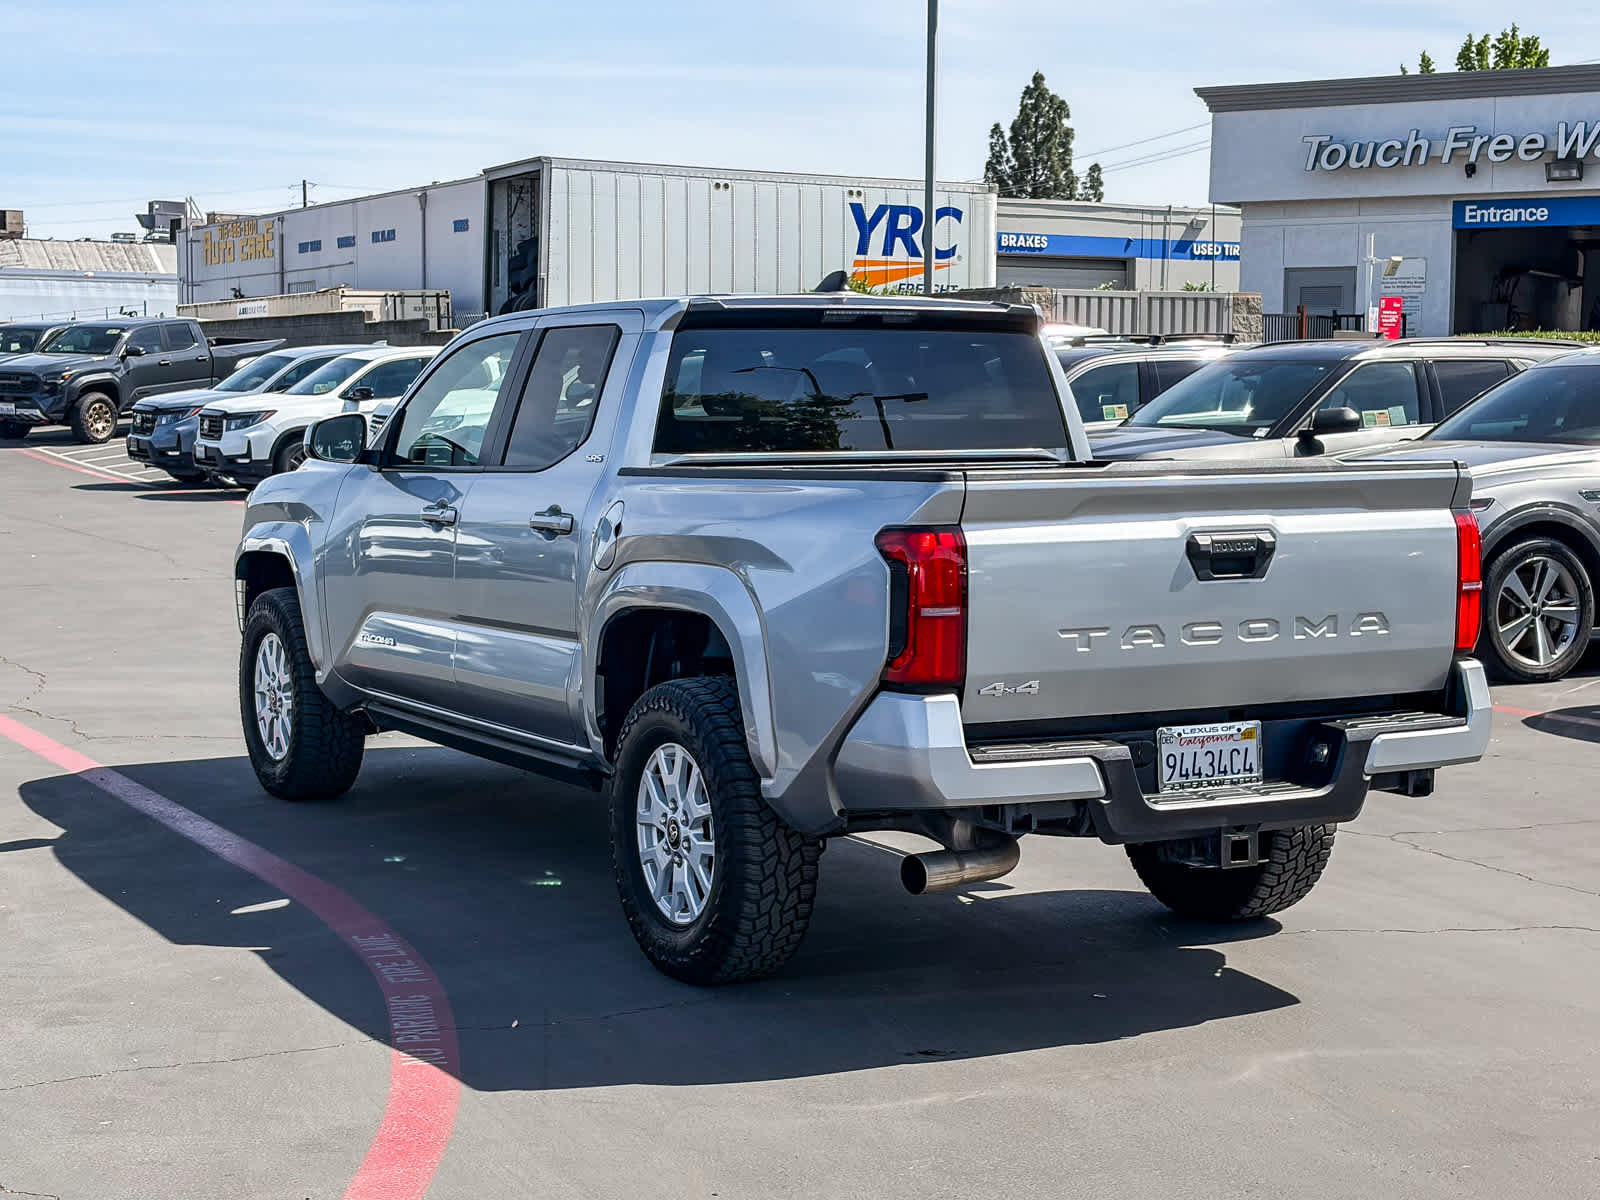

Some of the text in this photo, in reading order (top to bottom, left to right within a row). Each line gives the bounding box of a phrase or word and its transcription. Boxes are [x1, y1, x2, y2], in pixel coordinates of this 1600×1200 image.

[1303, 129, 1431, 172] Touch
[1440, 125, 1546, 165] Free
[1464, 205, 1549, 223] Entrance
[848, 202, 963, 260] YRC
[1001, 234, 1048, 249] BRAKES
[1193, 243, 1223, 256] USED
[1214, 542, 1257, 553] TOYOTA
[1057, 611, 1391, 653] TACOMA
[1182, 725, 1237, 735] LEXUS OF
[1161, 735, 1174, 745] DEC
[1178, 734, 1239, 749] California
[1166, 747, 1254, 782] 94434C4
[390, 994, 440, 1042] PARKING
